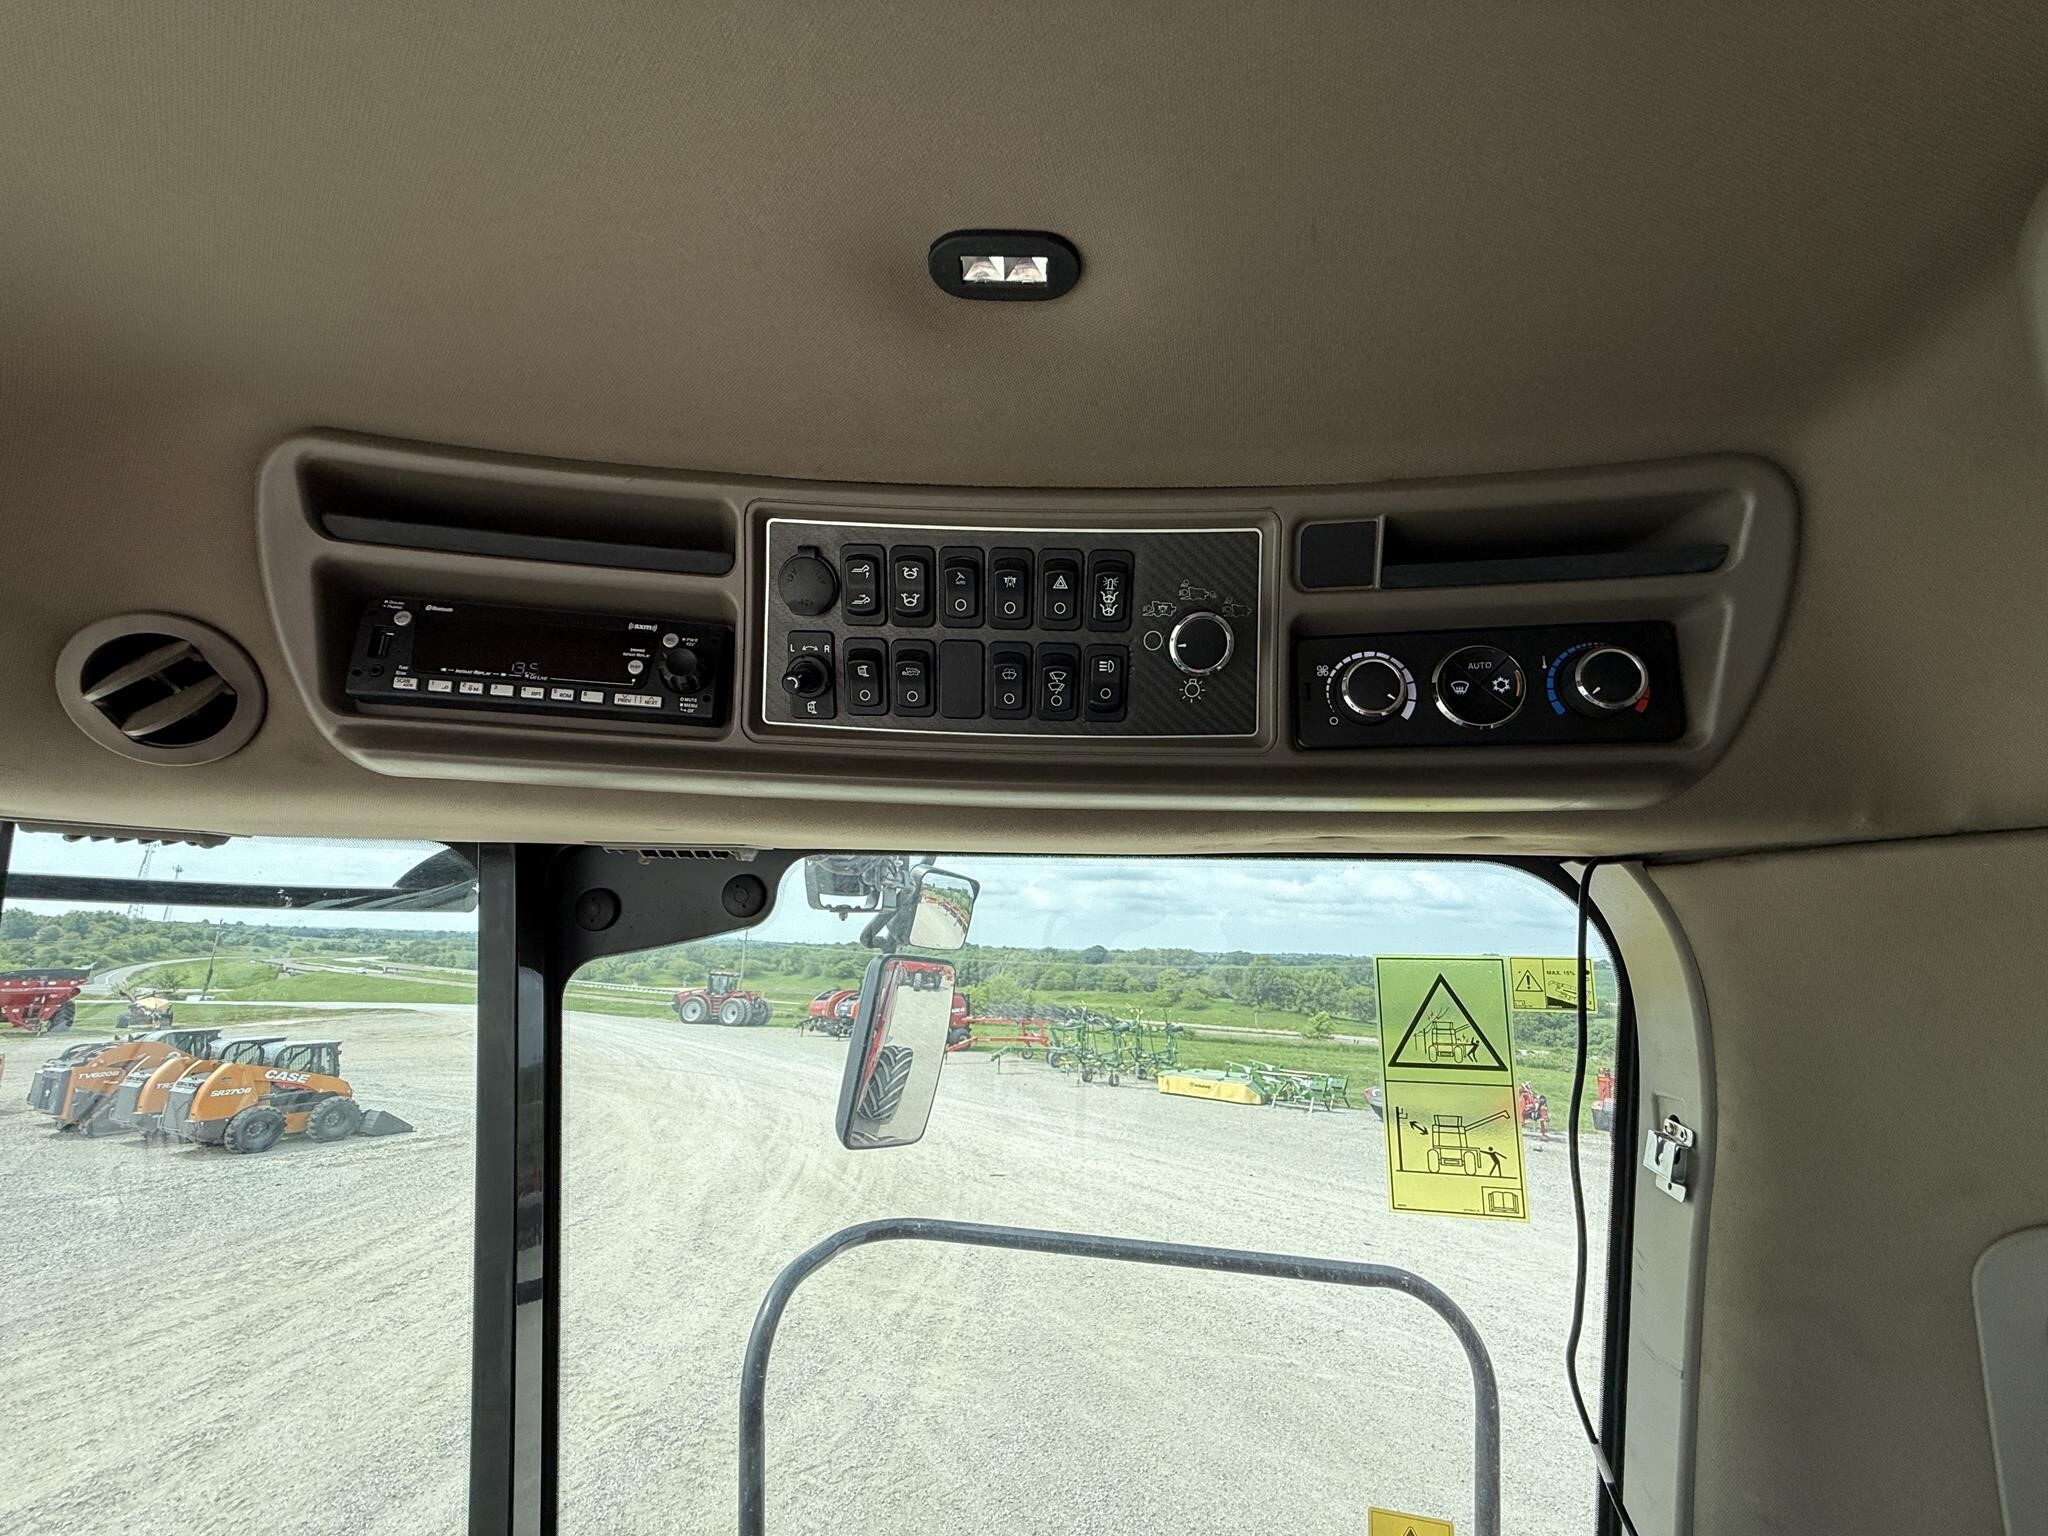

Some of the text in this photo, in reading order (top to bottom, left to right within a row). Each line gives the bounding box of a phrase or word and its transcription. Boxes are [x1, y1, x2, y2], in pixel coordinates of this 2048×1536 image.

[790, 644, 830, 653] L R
[1467, 661, 1492, 670] AUTO
[264, 1069, 311, 1084] CASE
